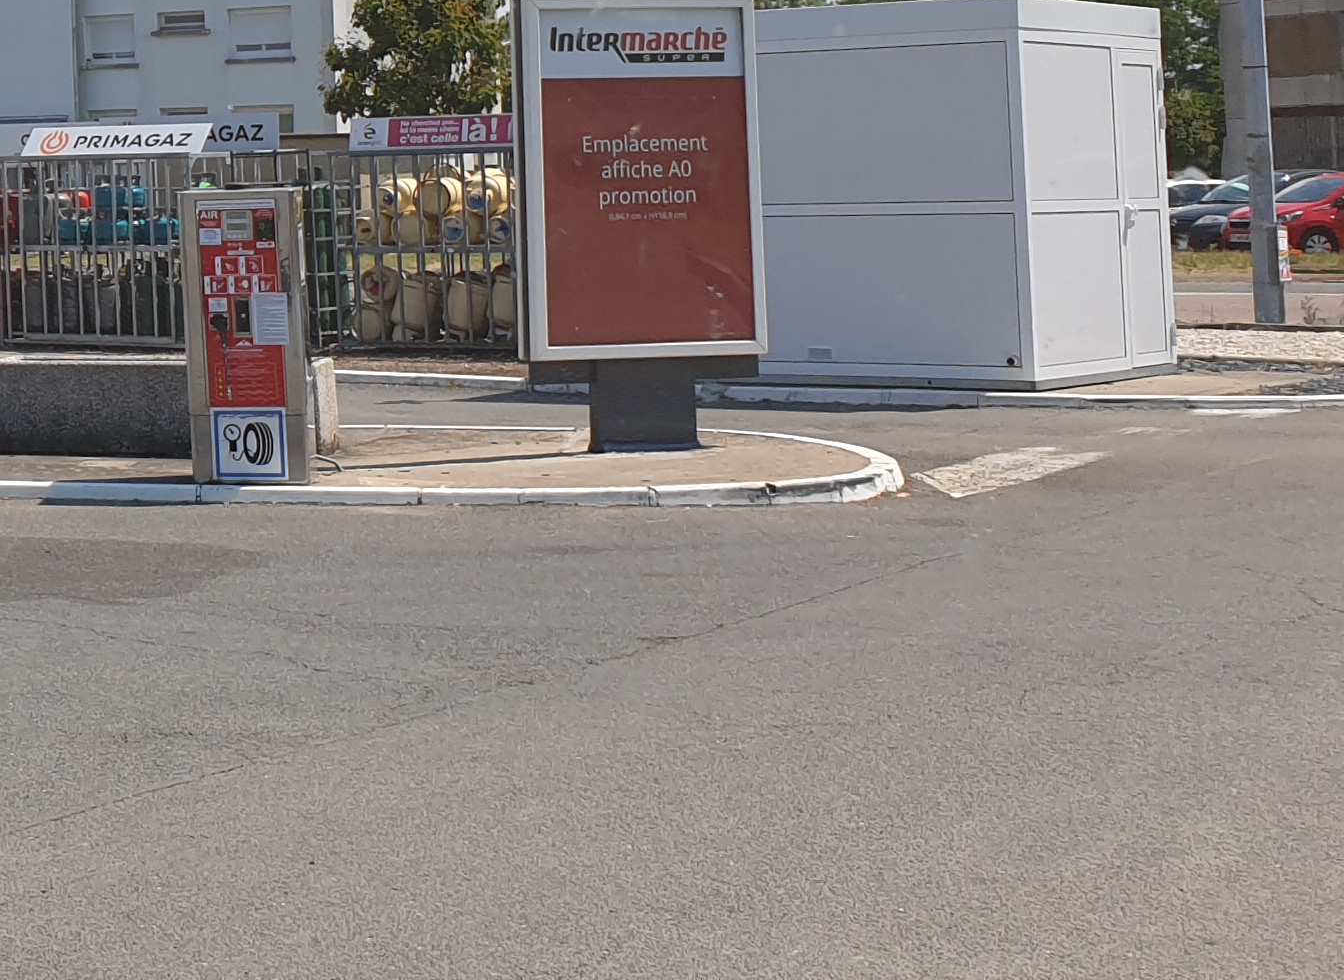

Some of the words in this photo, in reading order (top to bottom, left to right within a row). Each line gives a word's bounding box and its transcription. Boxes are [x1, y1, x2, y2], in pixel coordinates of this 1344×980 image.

[550, 26, 727, 64] Intermarché
[73, 132, 192, 149] PRIMAGAZ
[582, 134, 708, 158] Emplacement
[602, 158, 663, 179] affiche
[668, 159, 692, 178] A0
[599, 186, 697, 209] promotion
[200, 210, 218, 220] AIR
